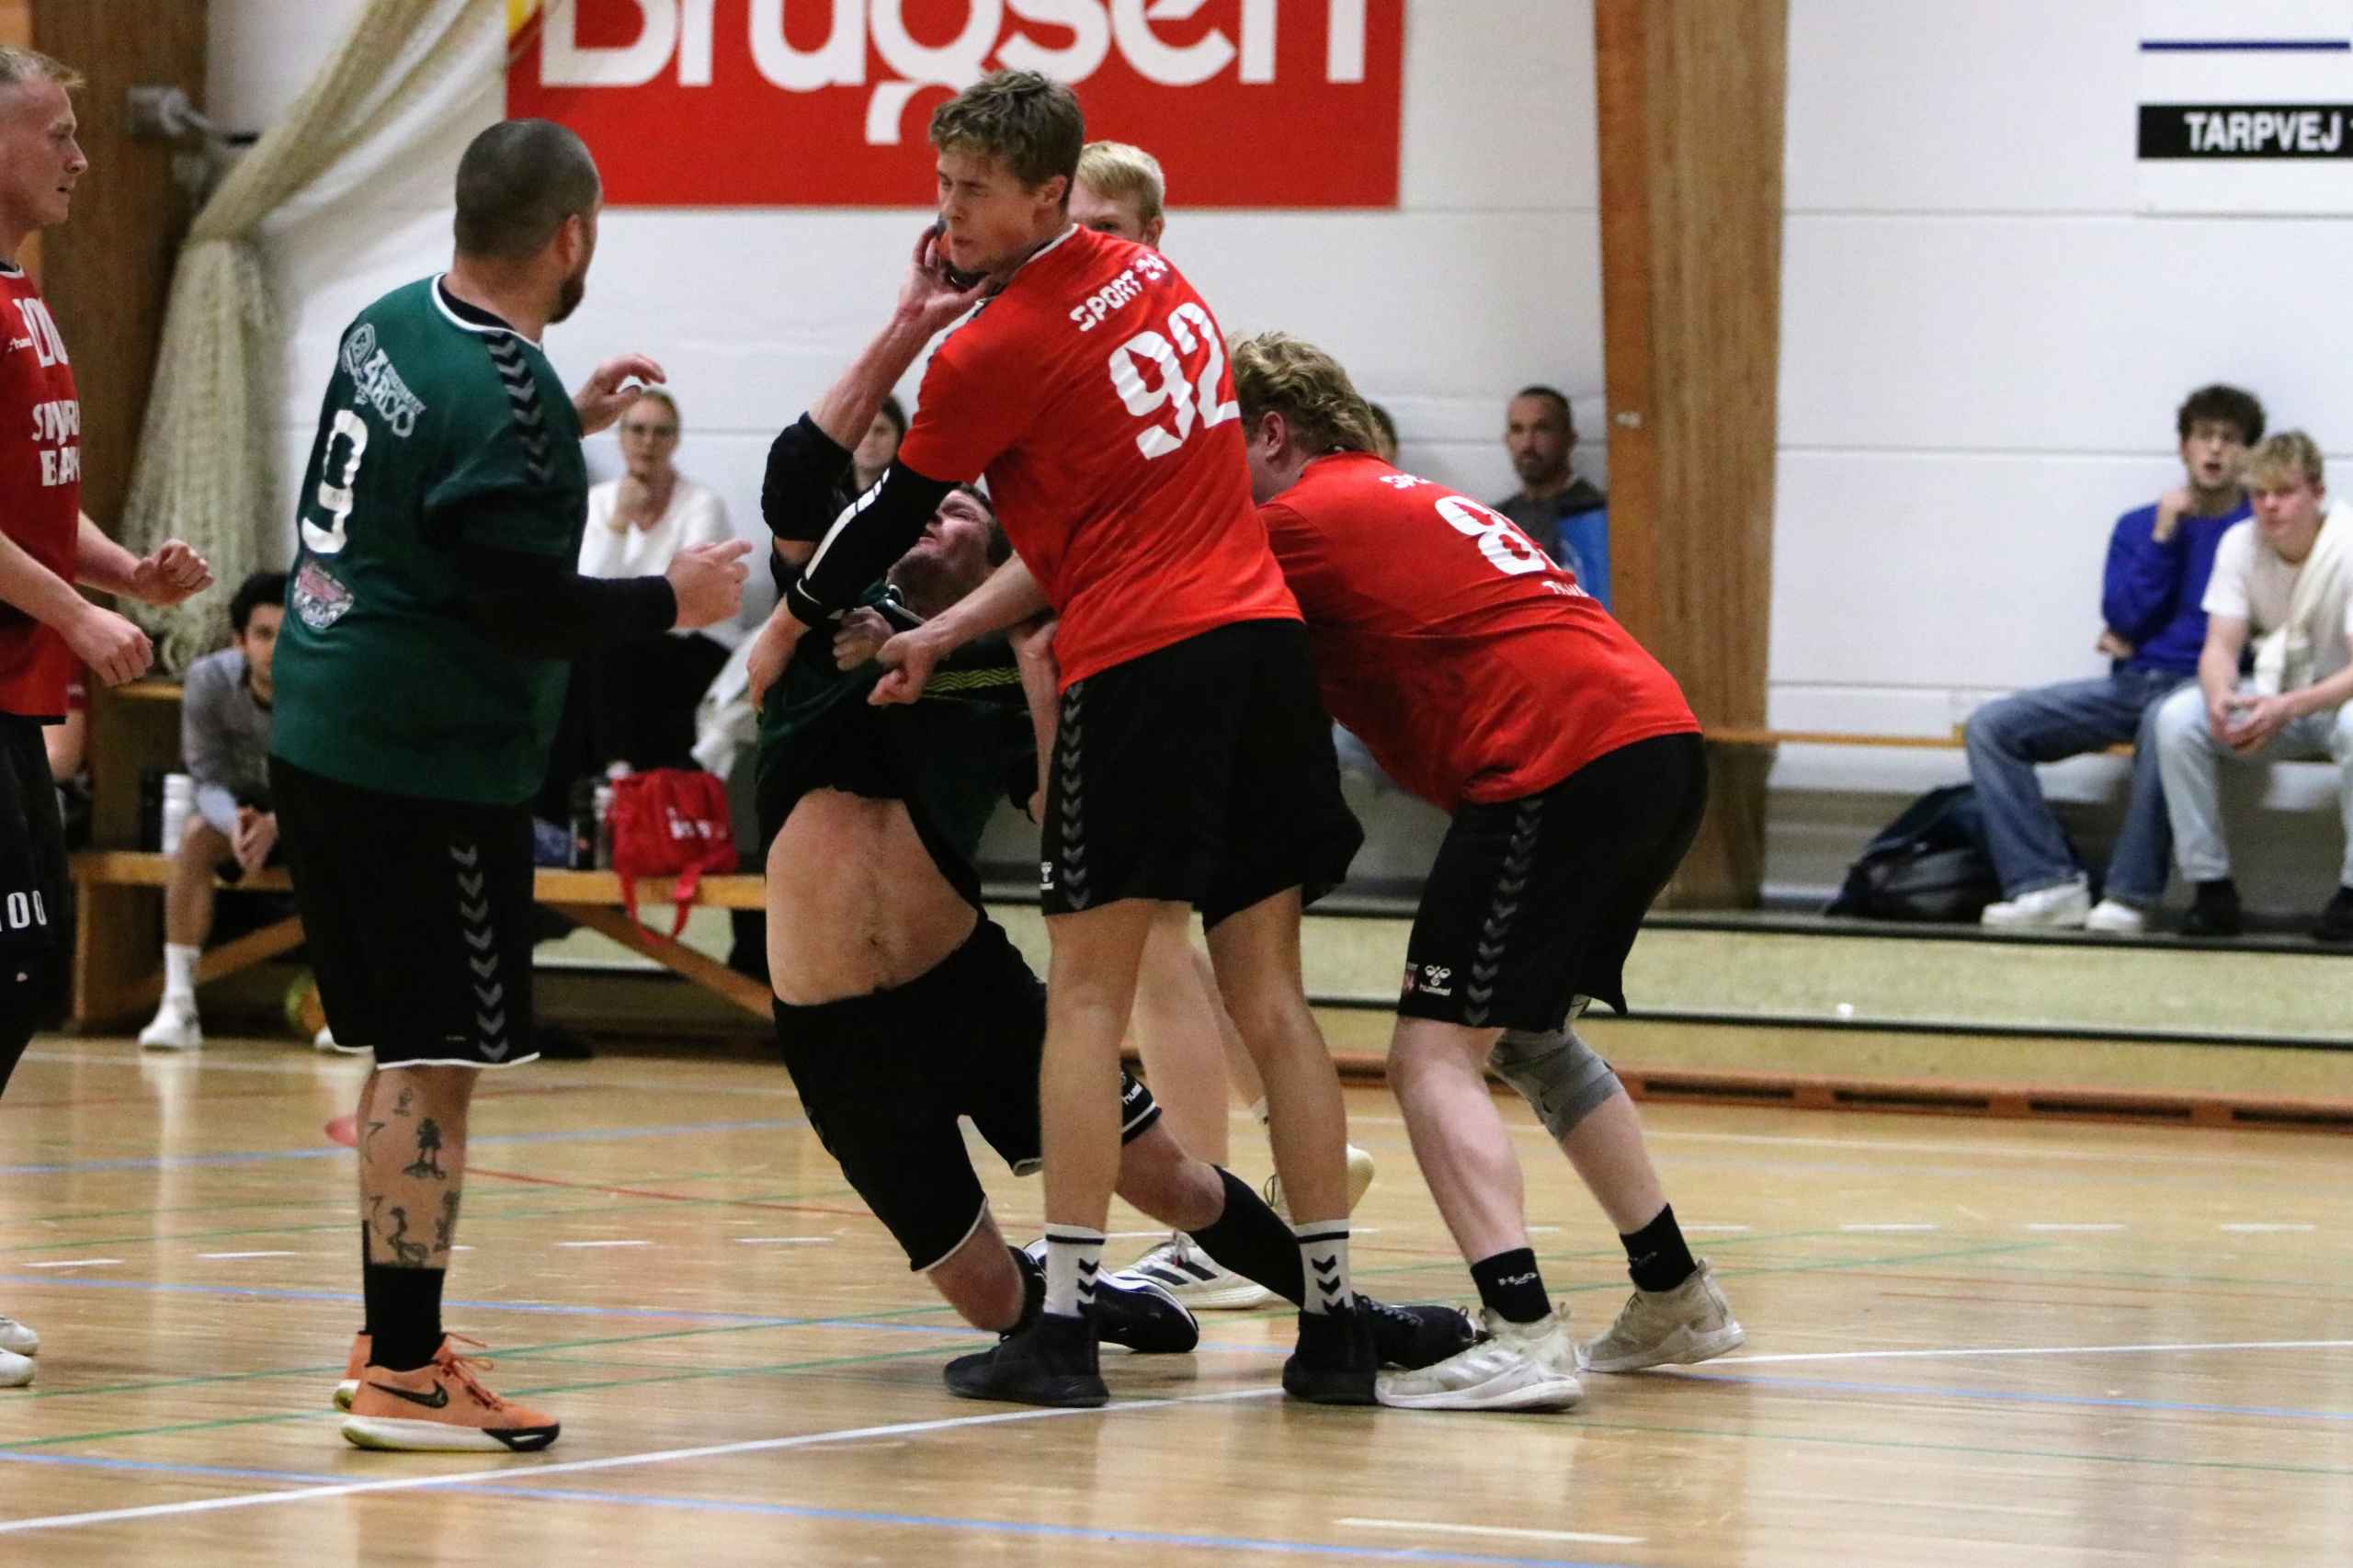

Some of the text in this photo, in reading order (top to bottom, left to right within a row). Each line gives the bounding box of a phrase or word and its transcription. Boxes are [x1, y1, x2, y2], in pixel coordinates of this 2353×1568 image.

[2183, 111, 2342, 152] TARPVEJ
[1069, 269, 1142, 332] SPORT
[1108, 302, 1241, 460] 92
[301, 410, 369, 554] 9
[0, 890, 48, 932] 00
